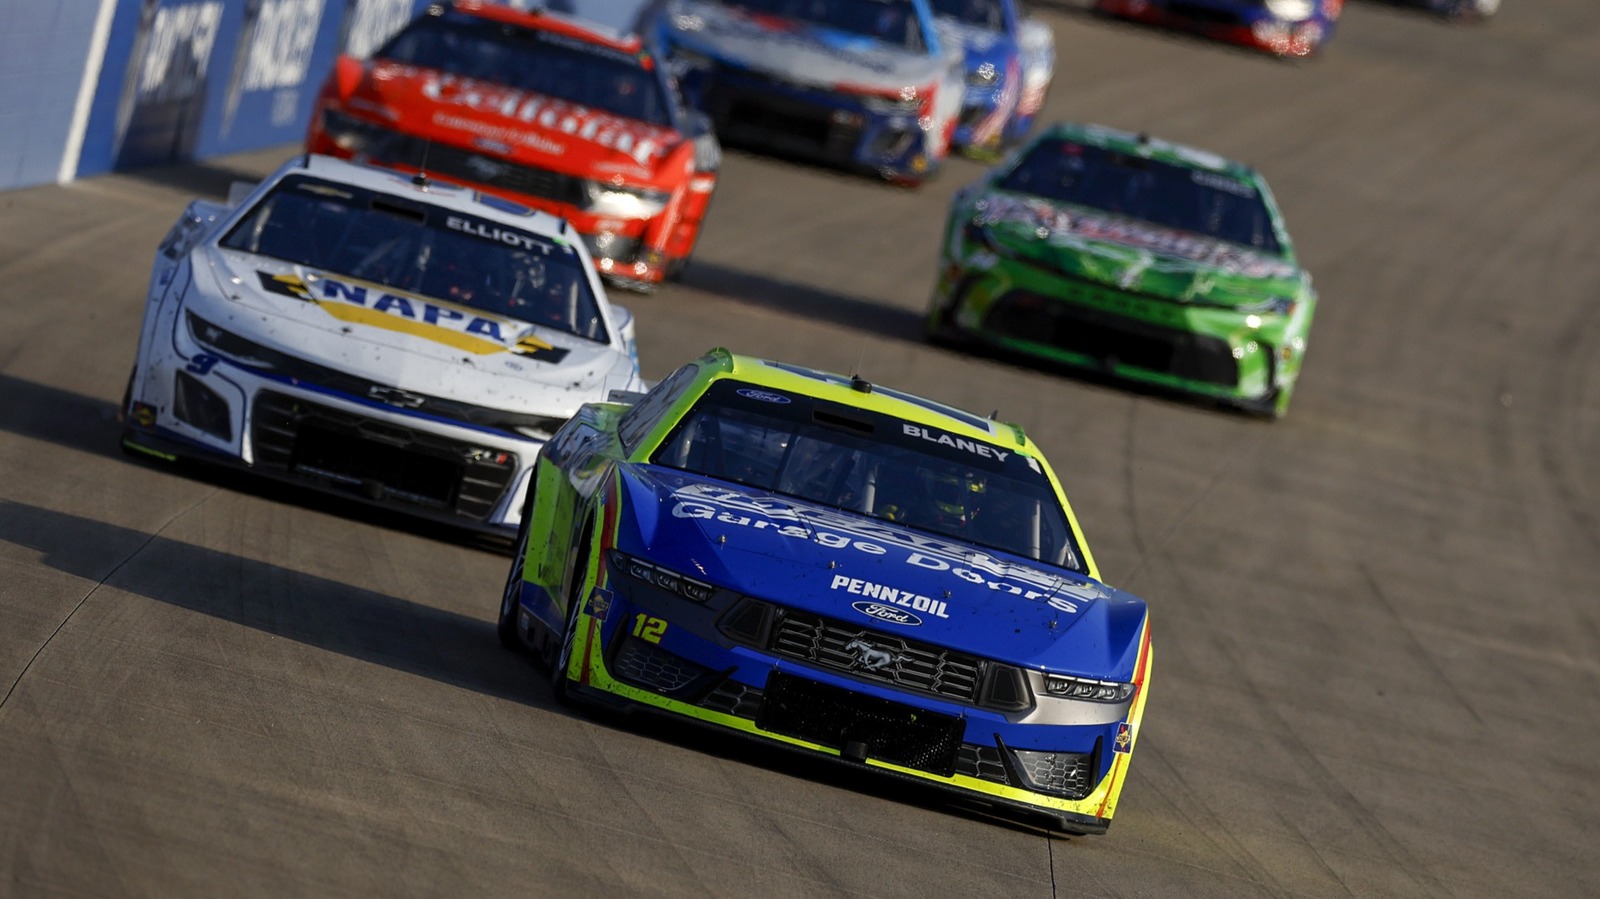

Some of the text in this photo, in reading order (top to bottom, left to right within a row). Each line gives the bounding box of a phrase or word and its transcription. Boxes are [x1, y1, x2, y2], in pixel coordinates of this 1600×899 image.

[446, 215, 554, 255] ELLIOTT
[323, 279, 505, 342] NAPA
[186, 353, 219, 376] 9
[902, 423, 1009, 462] BLANEY
[671, 500, 887, 555] Garage
[905, 552, 1079, 614] Doors
[830, 574, 950, 619] PENNZOIL
[864, 603, 910, 624] Ford
[632, 612, 668, 645] 12
